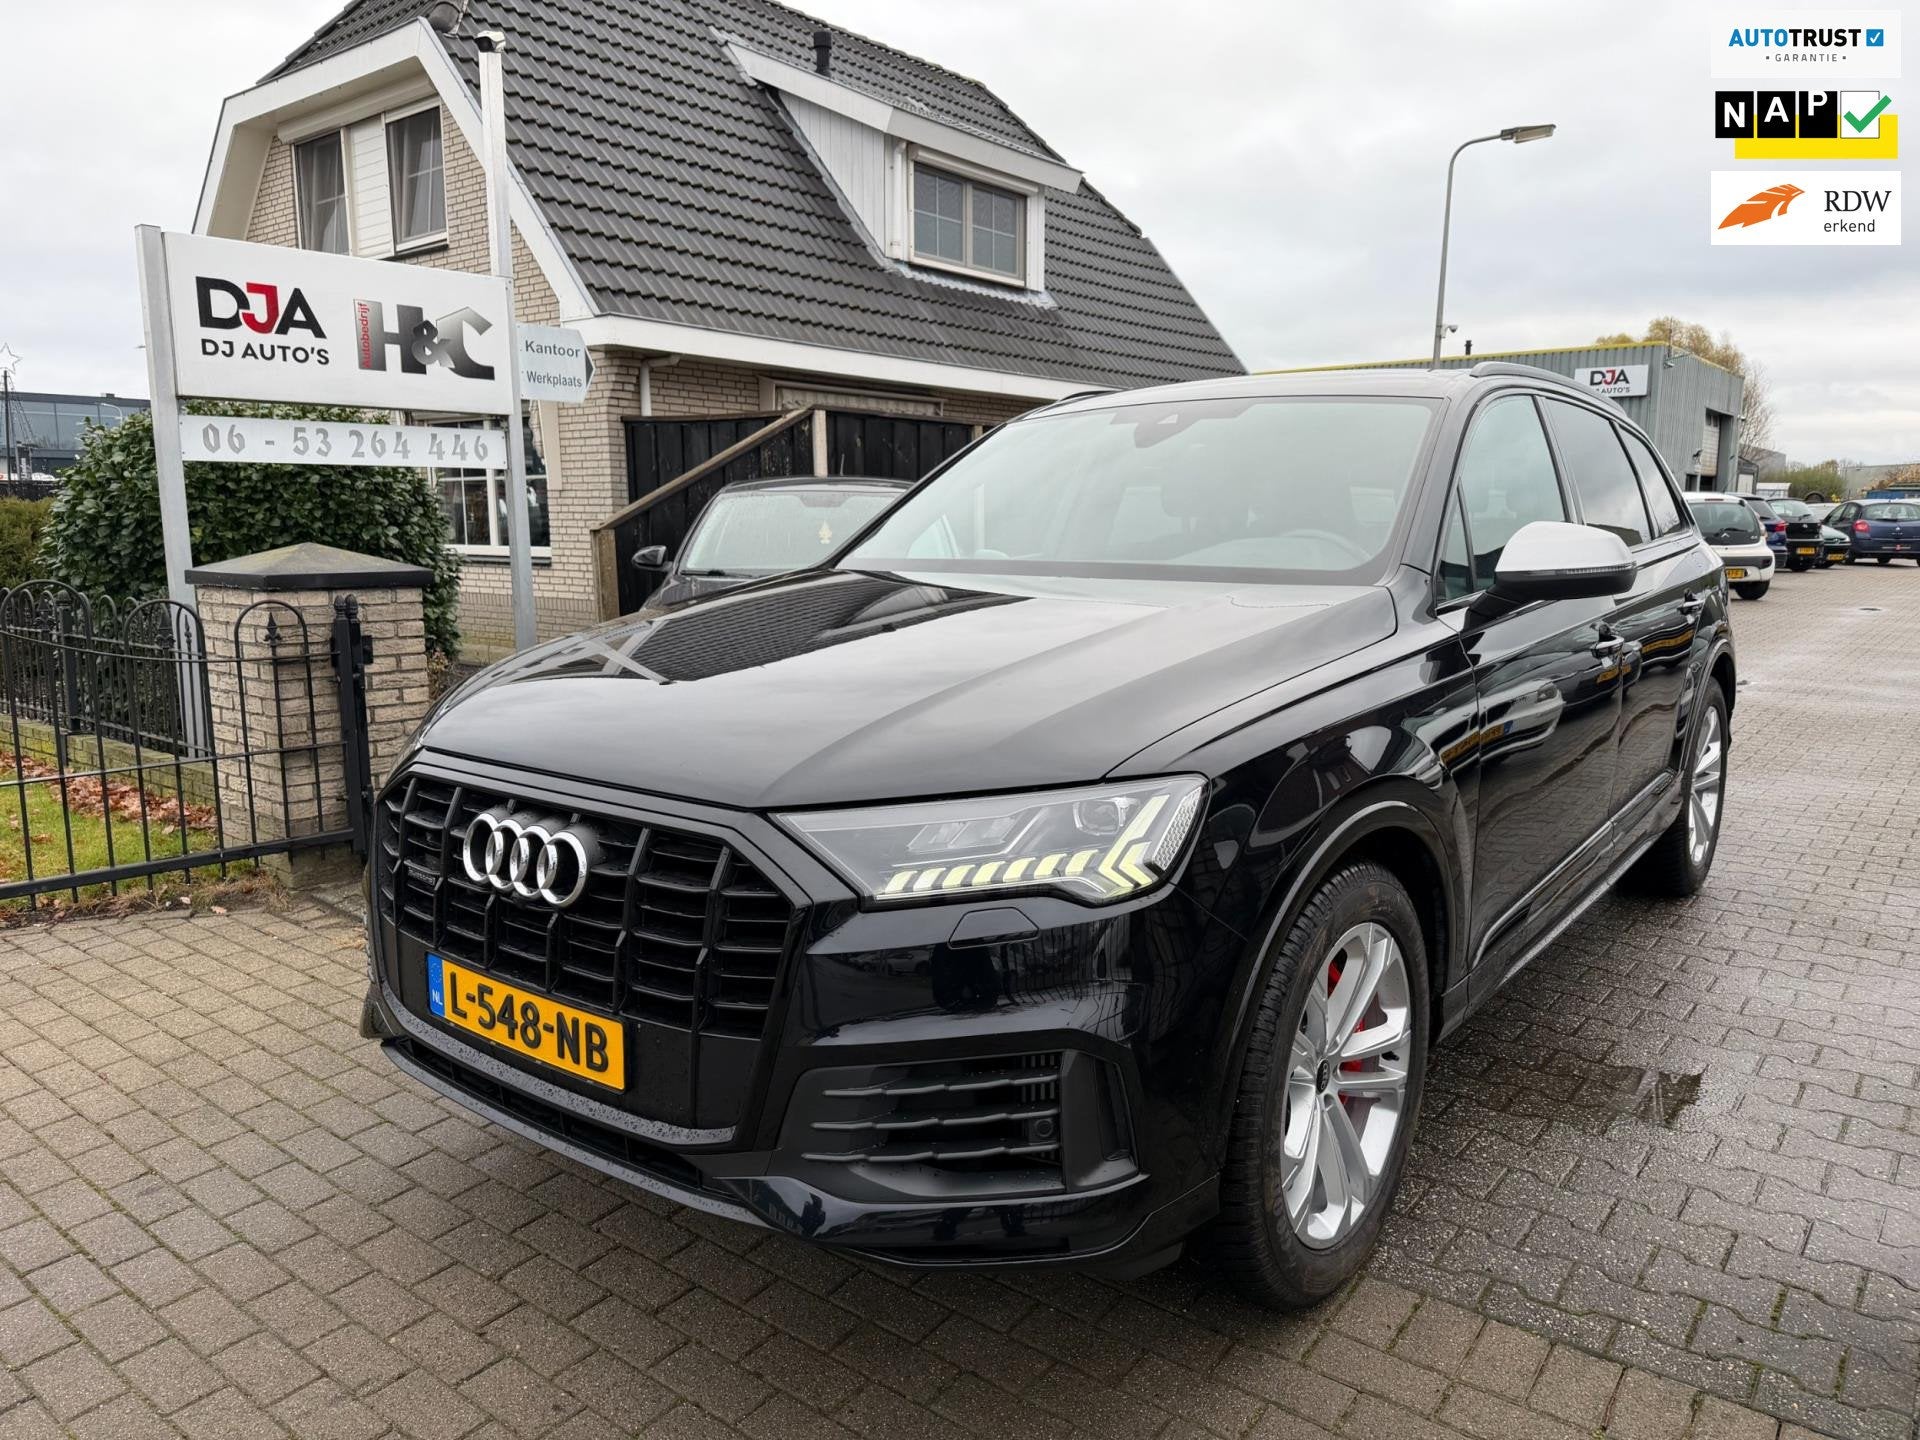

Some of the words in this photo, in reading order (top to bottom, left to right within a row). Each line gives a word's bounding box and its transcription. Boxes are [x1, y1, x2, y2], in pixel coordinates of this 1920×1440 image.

[195, 276, 328, 339] DJA
[353, 299, 495, 381] H&C
[357, 301, 373, 369] Autobedrijf
[525, 340, 581, 358] Kantoor
[201, 338, 235, 357] DJ
[241, 342, 330, 365] AUTO'S
[526, 370, 583, 388] Werkplaats
[1590, 369, 1630, 386] DJA
[202, 423, 246, 454] 06
[293, 427, 332, 457] 53
[349, 430, 411, 459] 264
[428, 433, 489, 461] 446
[431, 987, 443, 1006] NL
[450, 971, 609, 1073] L-548-NB
